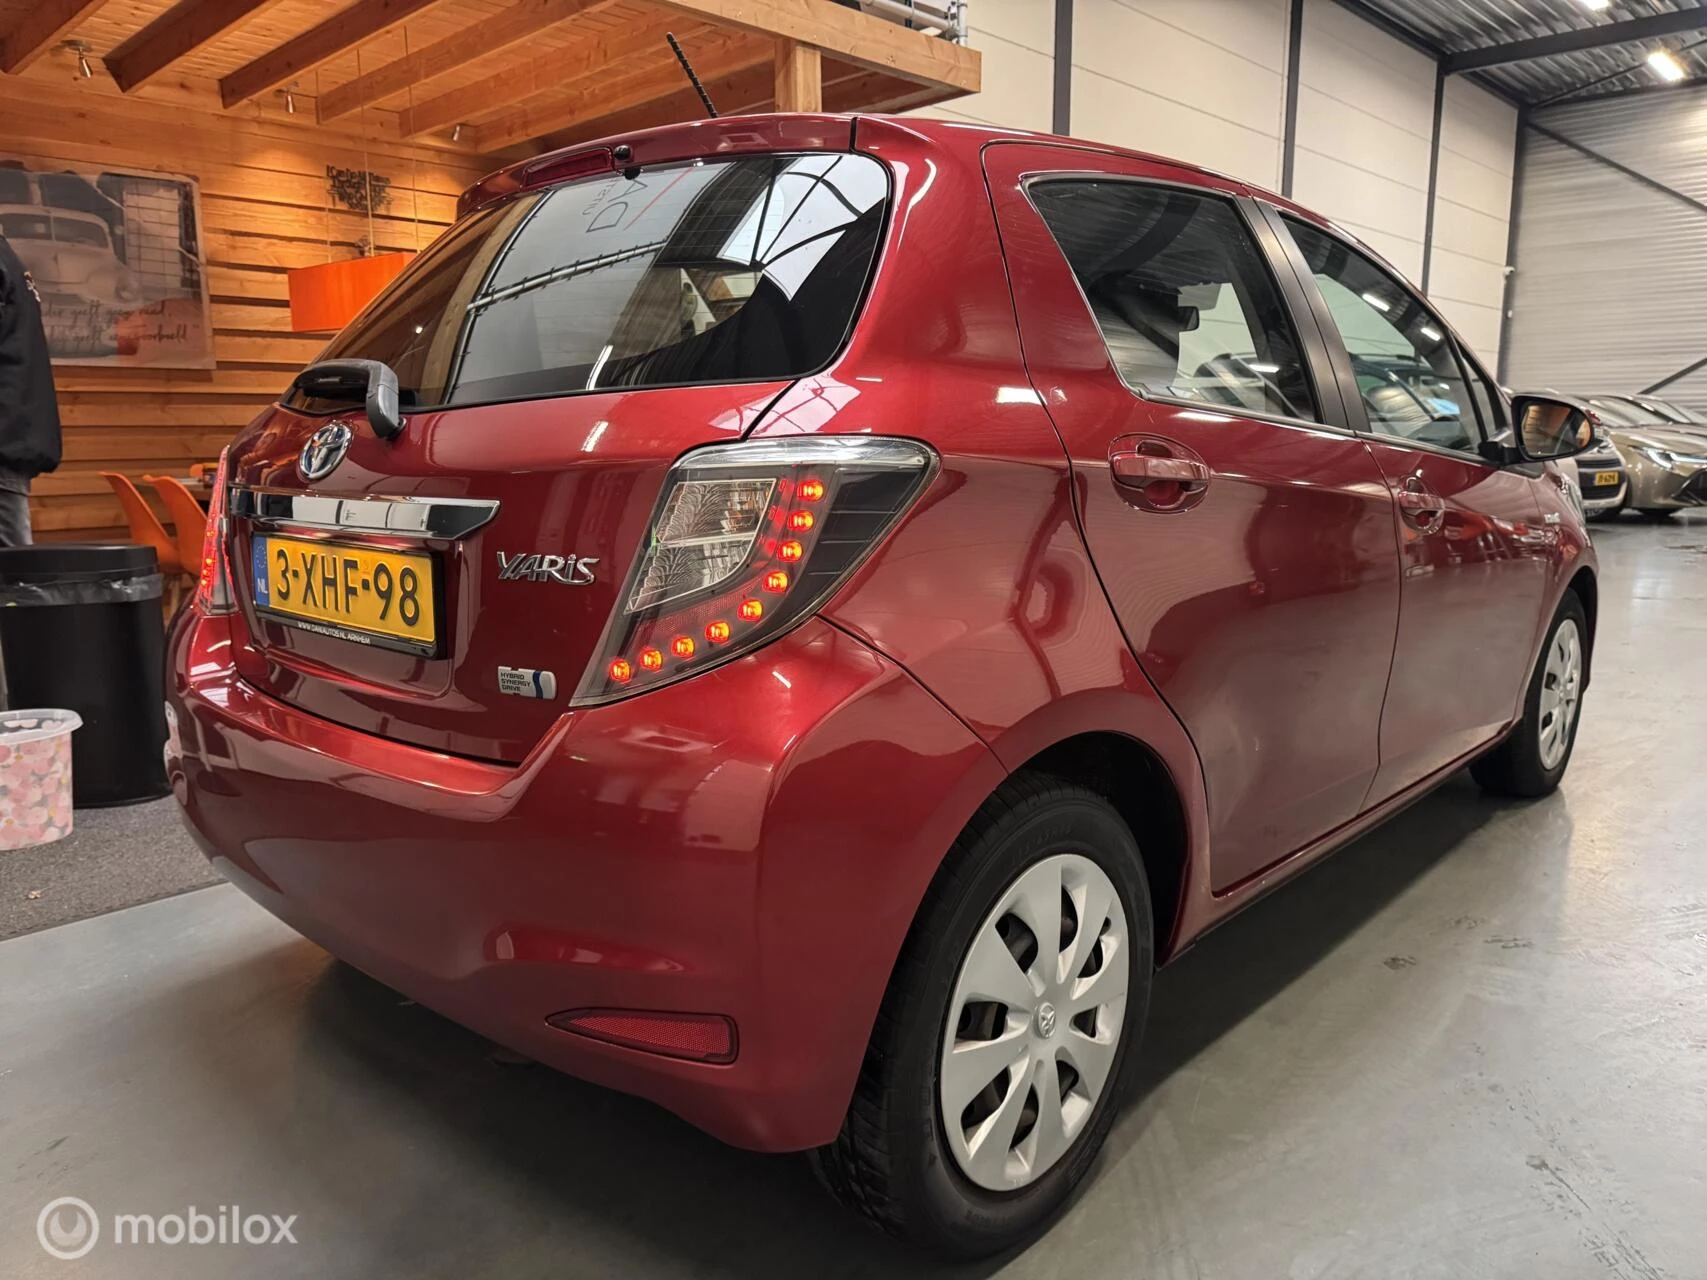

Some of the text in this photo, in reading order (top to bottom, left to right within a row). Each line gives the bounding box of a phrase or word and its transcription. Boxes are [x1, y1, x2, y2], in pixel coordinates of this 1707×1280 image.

[257, 577, 268, 594] NL
[276, 548, 420, 628] 3-XHF-98
[500, 671, 525, 680] HYBRID
[501, 678, 531, 687] SYNERGY
[501, 684, 521, 692] DRIVE
